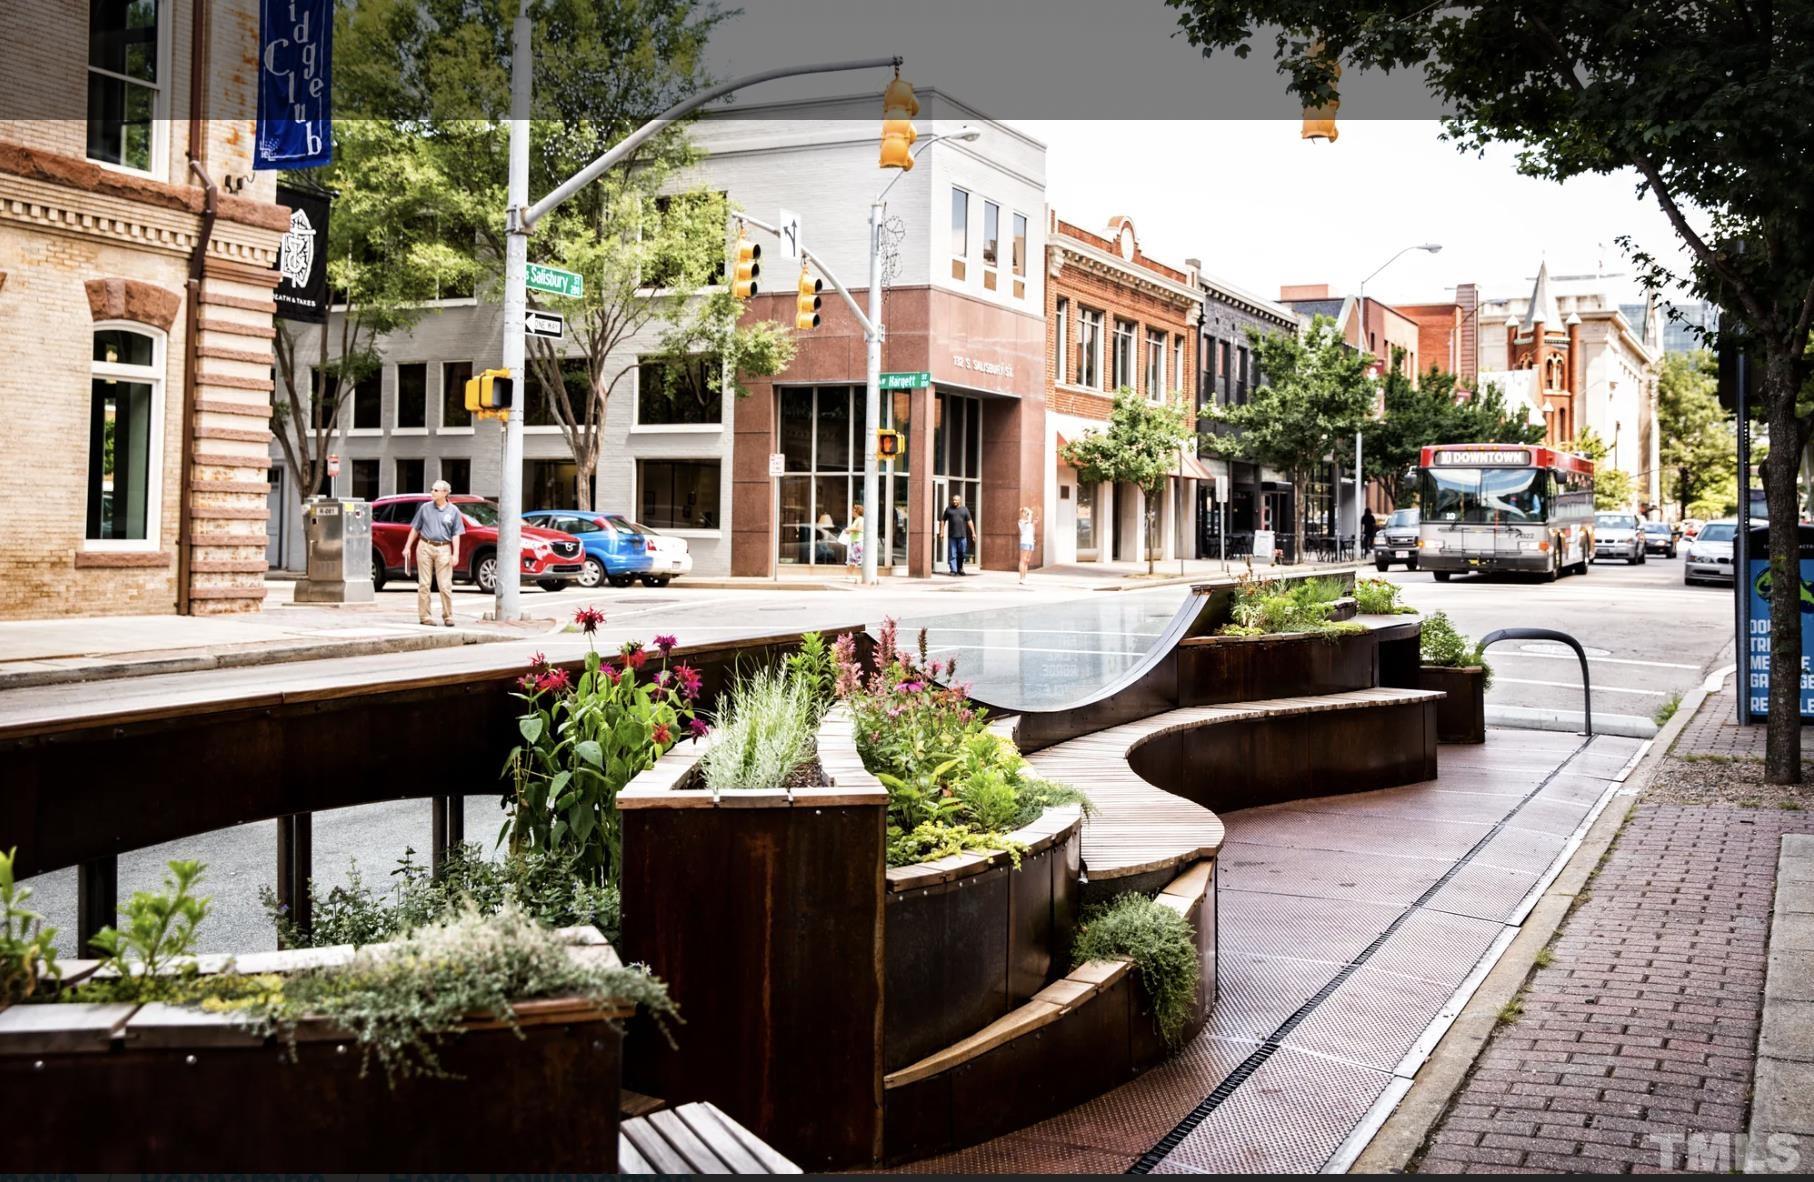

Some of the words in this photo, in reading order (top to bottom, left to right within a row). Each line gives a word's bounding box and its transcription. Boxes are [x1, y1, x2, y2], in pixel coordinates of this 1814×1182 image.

[264, 38, 322, 156] Club
[531, 265, 568, 293] Salisbury
[296, 297, 316, 307] TAXES
[534, 319, 546, 330] ONE
[547, 322, 558, 330] WAY
[972, 360, 1004, 376] SALISBURY
[889, 375, 916, 389] Hargett
[1453, 451, 1523, 465] DOWNTOWN
